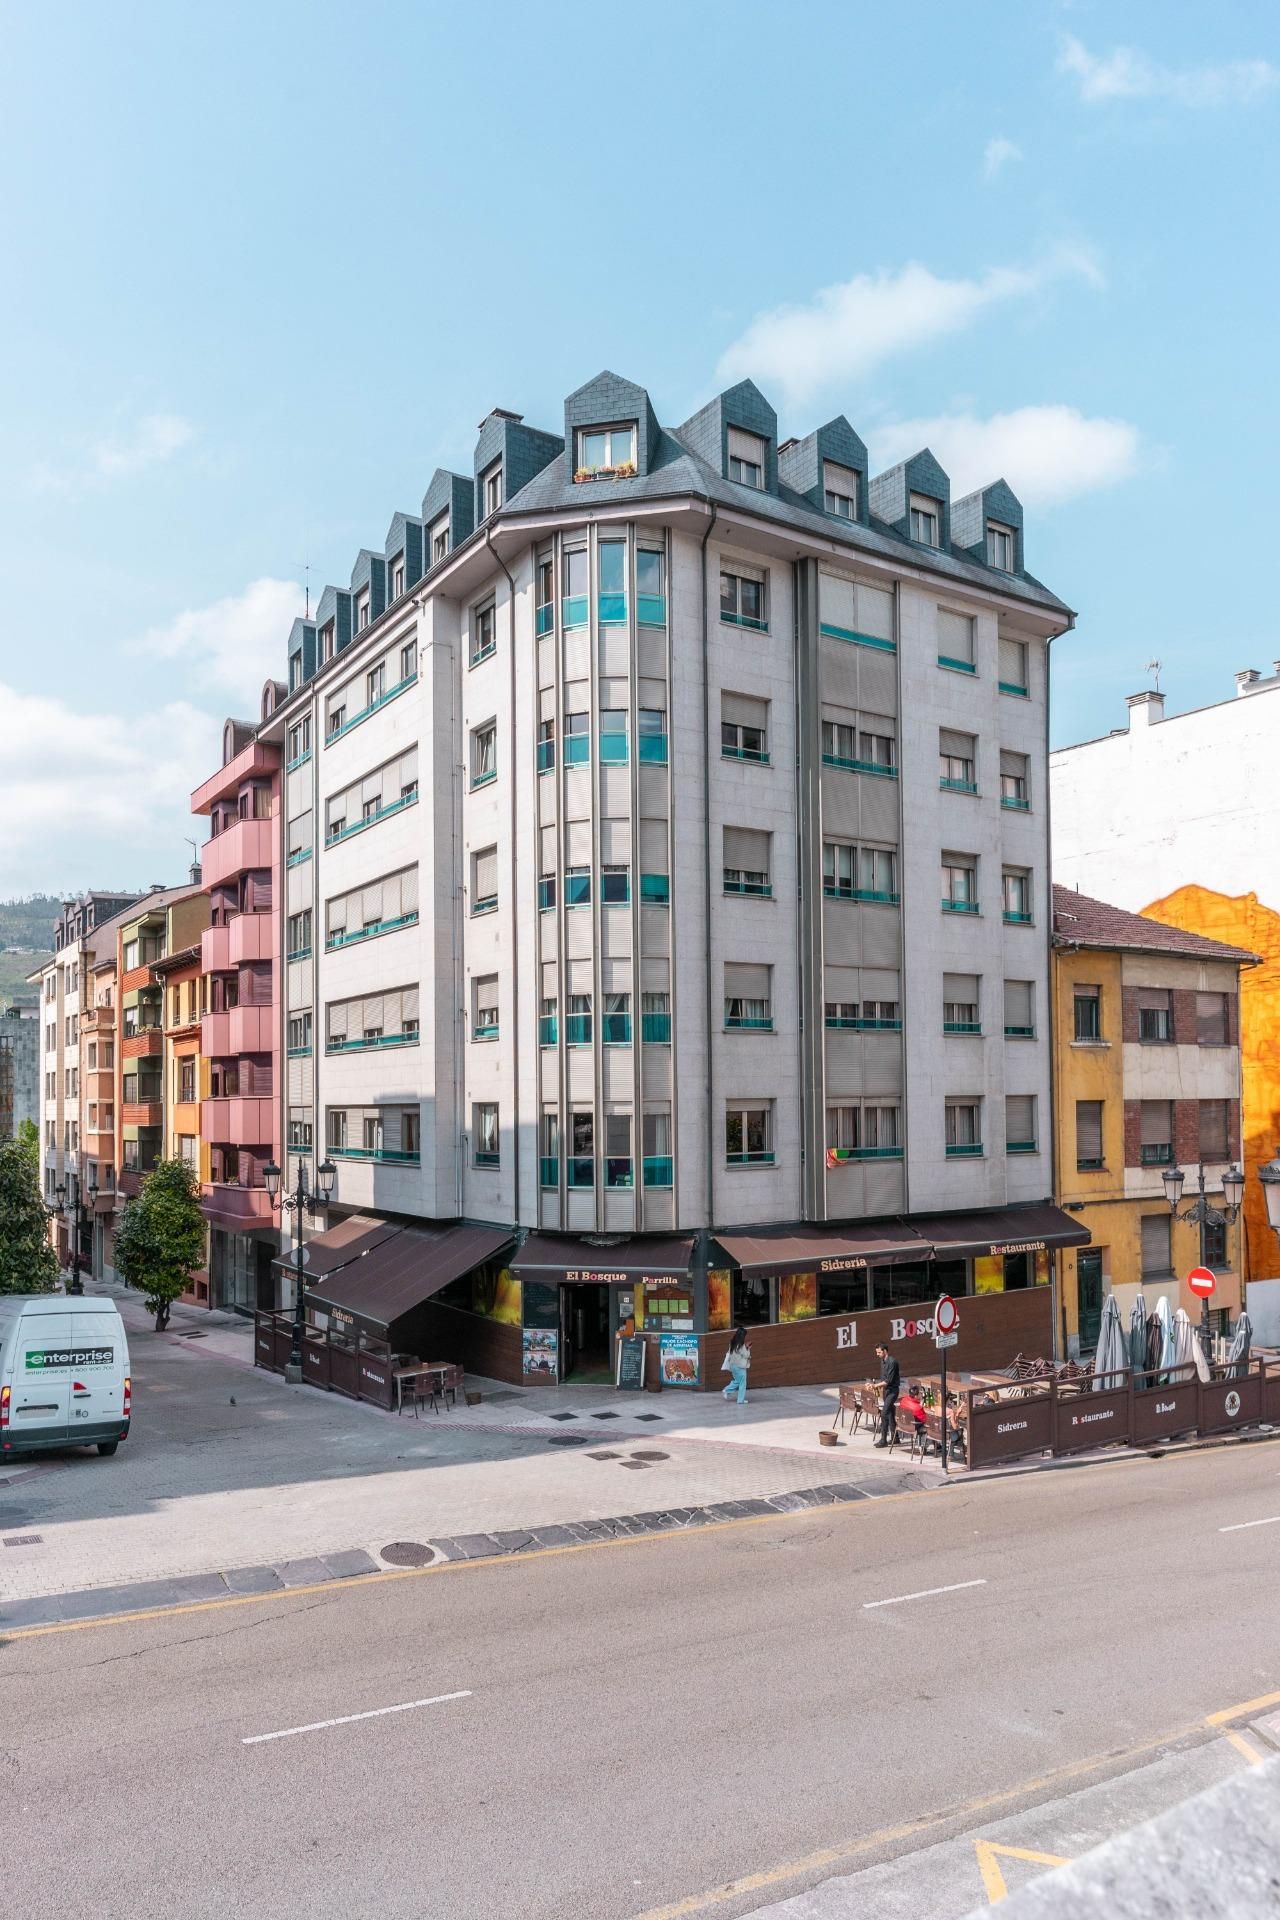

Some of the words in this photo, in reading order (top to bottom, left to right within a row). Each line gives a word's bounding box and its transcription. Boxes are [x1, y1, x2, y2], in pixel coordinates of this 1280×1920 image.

[990, 1241, 1046, 1255] Restaurante
[821, 1257, 867, 1271] Sidrería
[566, 1271, 579, 1281] El
[582, 1271, 627, 1283] Bosque
[642, 1276, 678, 1284] Parrilla
[836, 1321, 858, 1349] El
[890, 1315, 960, 1340] Bosqe
[26, 1350, 113, 1365] enterprise
